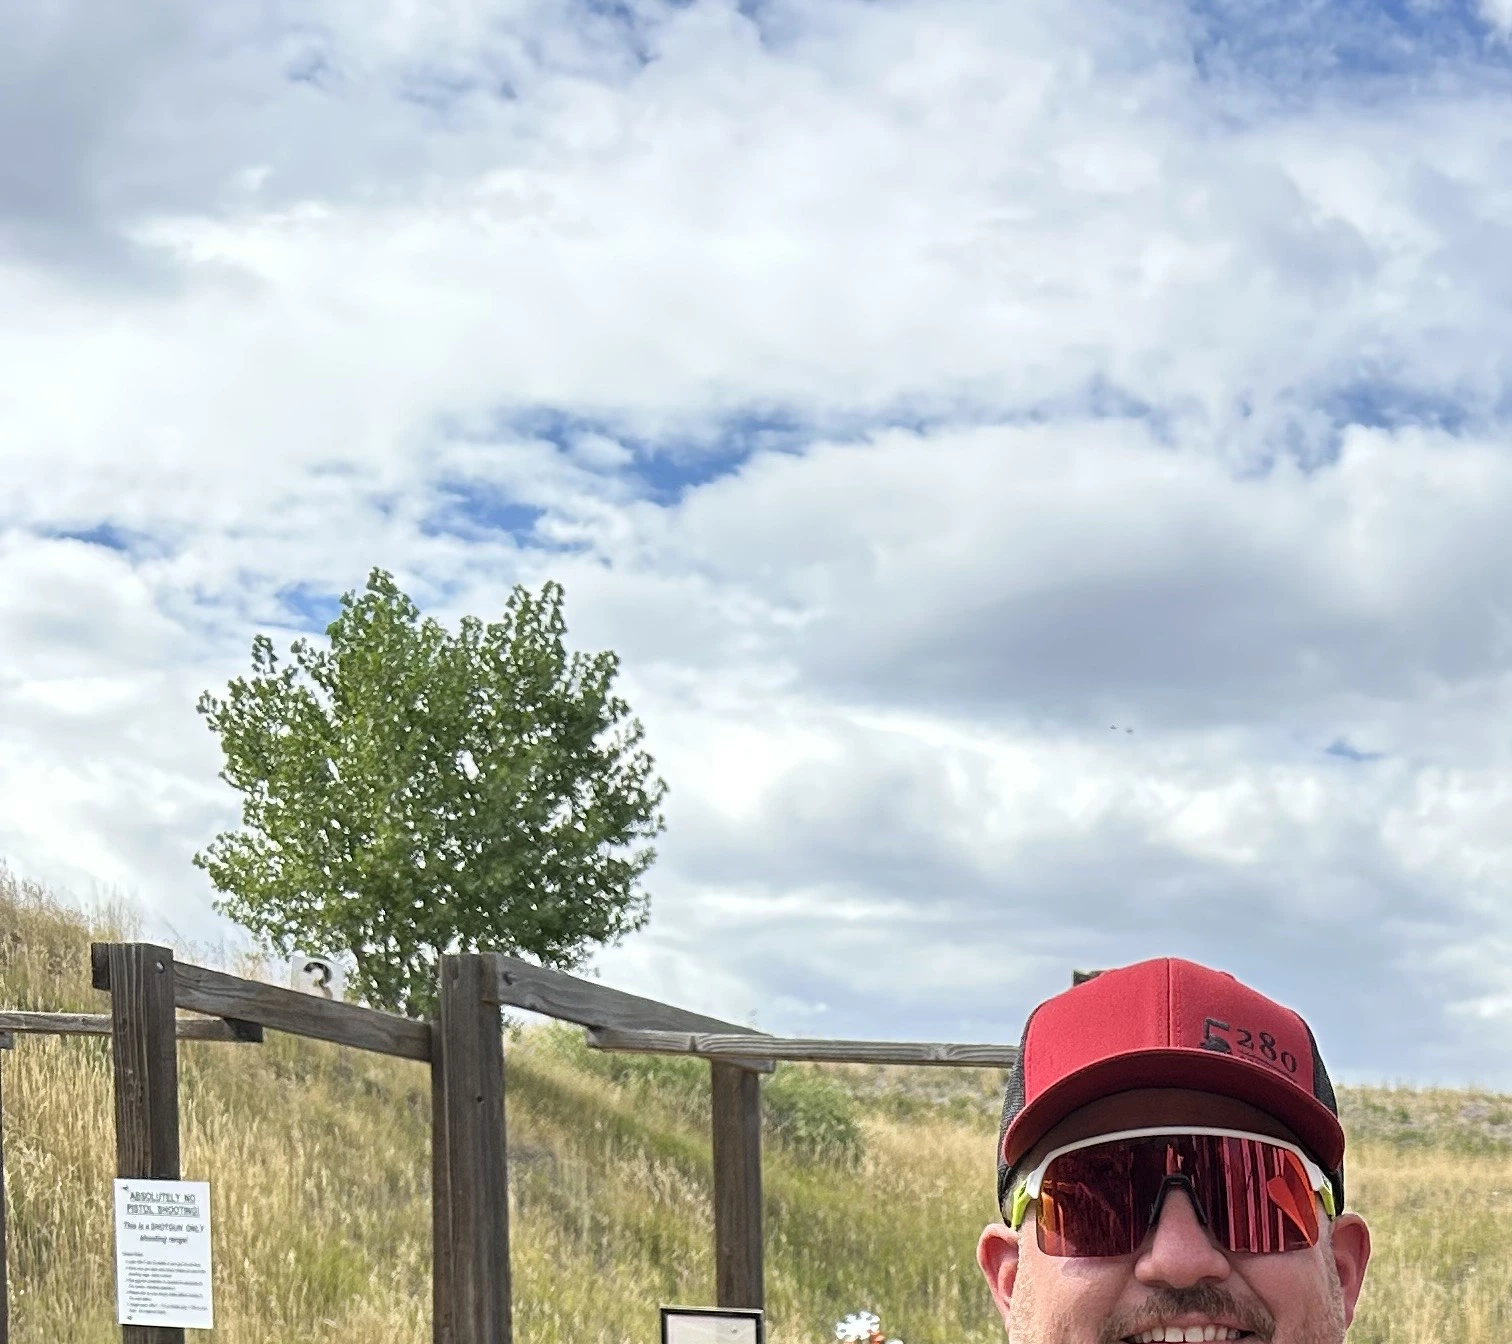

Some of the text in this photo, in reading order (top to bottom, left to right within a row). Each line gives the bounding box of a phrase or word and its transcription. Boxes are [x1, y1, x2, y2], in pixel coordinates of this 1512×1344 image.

[1201, 1016, 1297, 1073] 5280
[130, 1192, 196, 1203] ABSOLUTELY NO
[127, 1204, 154, 1215] PISTOL
